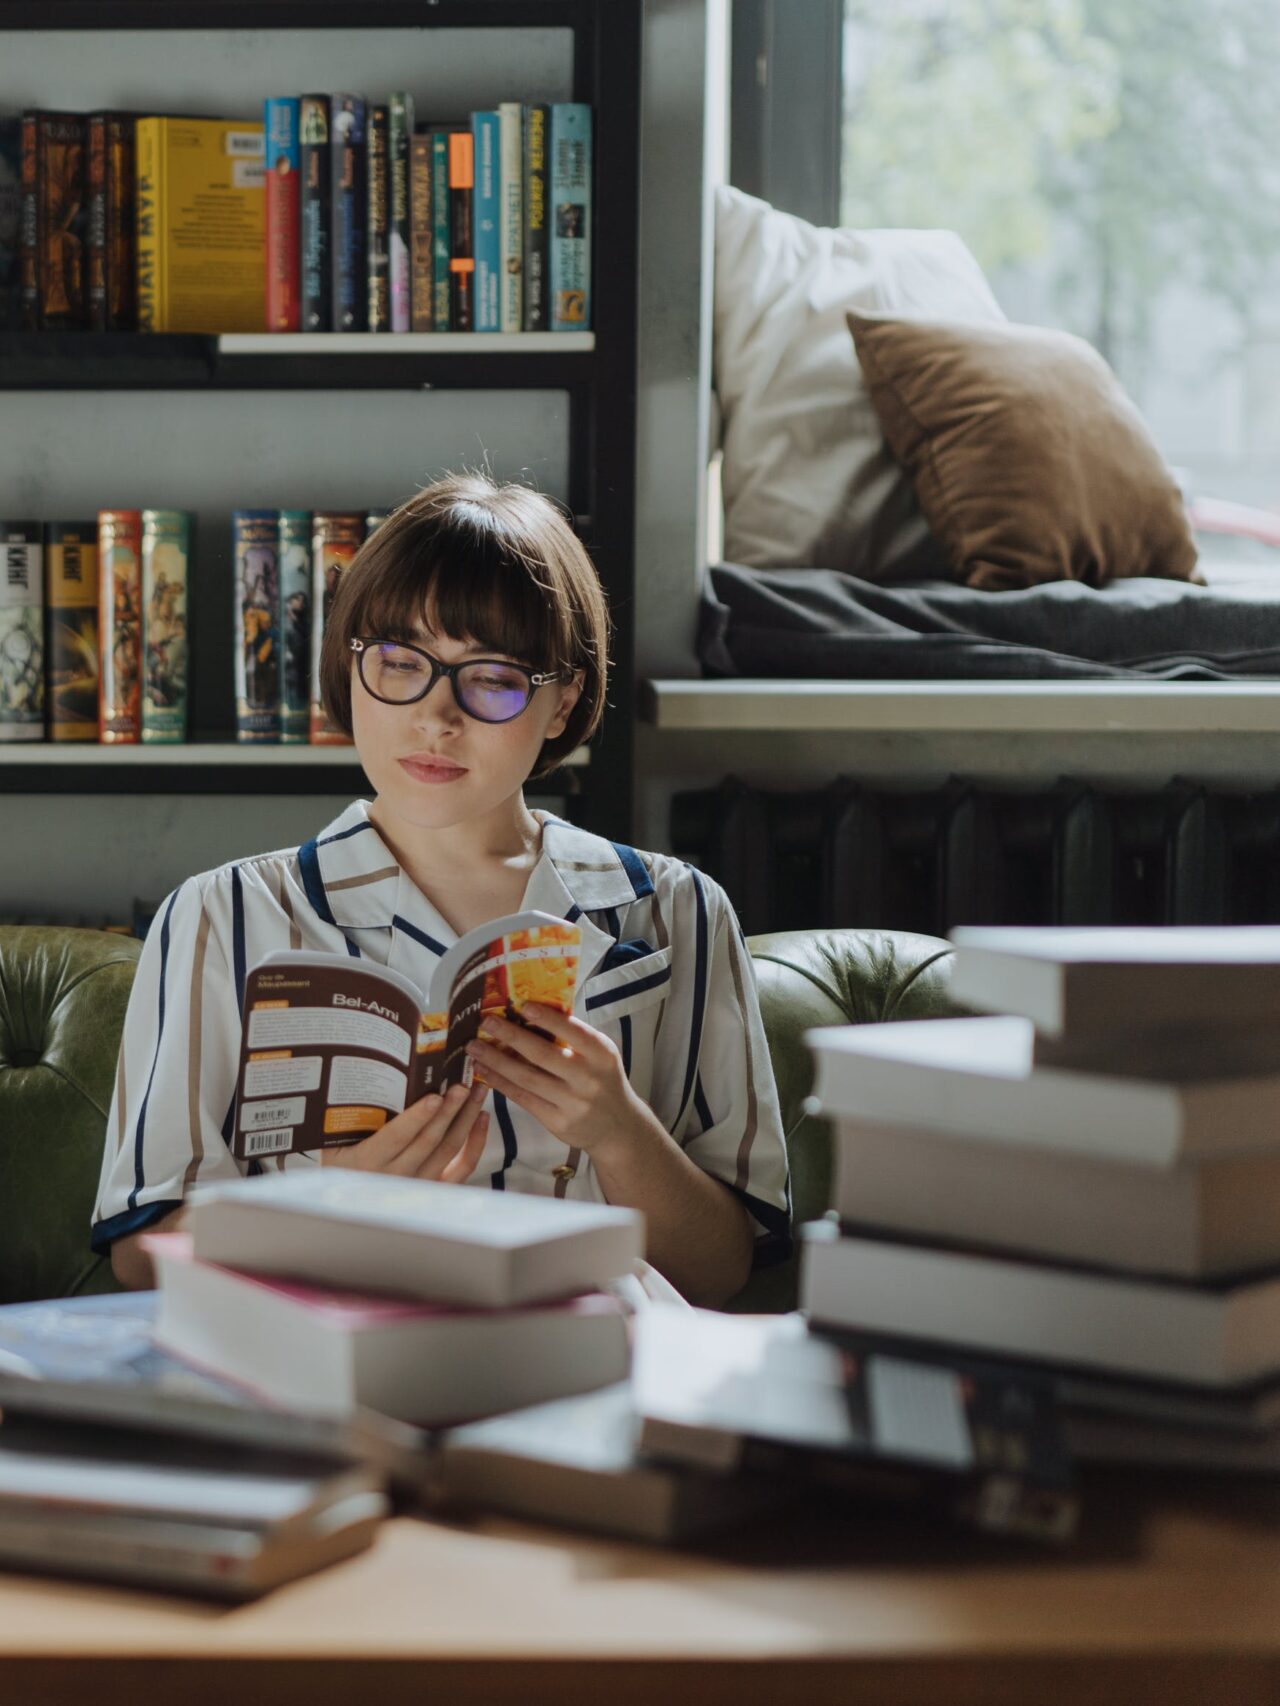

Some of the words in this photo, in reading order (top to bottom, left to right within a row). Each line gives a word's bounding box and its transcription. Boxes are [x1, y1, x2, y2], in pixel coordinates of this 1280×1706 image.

[137, 175, 154, 237] МУР
[137, 250, 154, 332] АЛАН
[7, 546, 28, 590] КИНГ
[62, 546, 81, 583] КИНГ
[332, 993, 399, 1022] Bel-Ami
